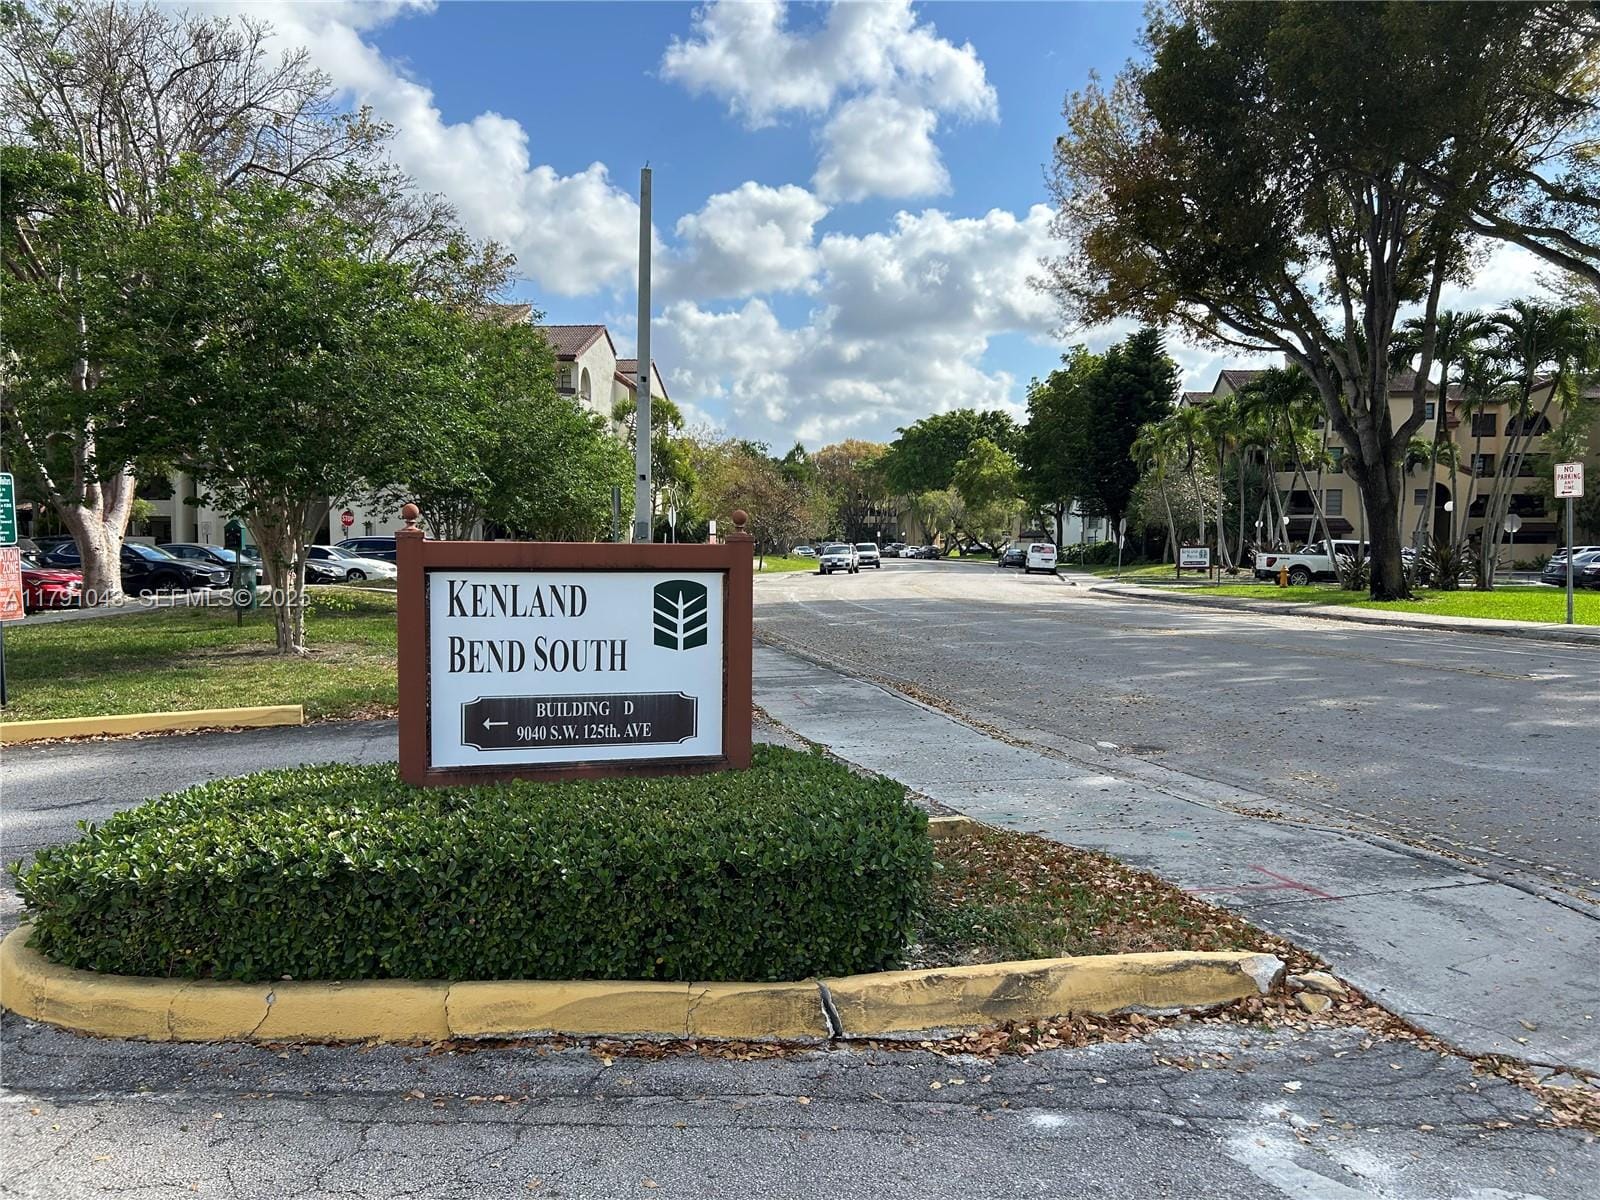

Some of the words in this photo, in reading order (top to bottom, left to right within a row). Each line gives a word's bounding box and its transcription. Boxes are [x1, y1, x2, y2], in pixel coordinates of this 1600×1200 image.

[2, 562, 19, 573] ZONE
[446, 579, 588, 618] KENLAND
[448, 635, 526, 674] BEND
[533, 635, 628, 673] SOUTH
[536, 700, 610, 718] BUILDING
[623, 700, 634, 716] D
[516, 725, 547, 741] 9040
[550, 724, 579, 740] S.W.
[583, 723, 621, 739] 125th.
[623, 722, 652, 737] AVE
